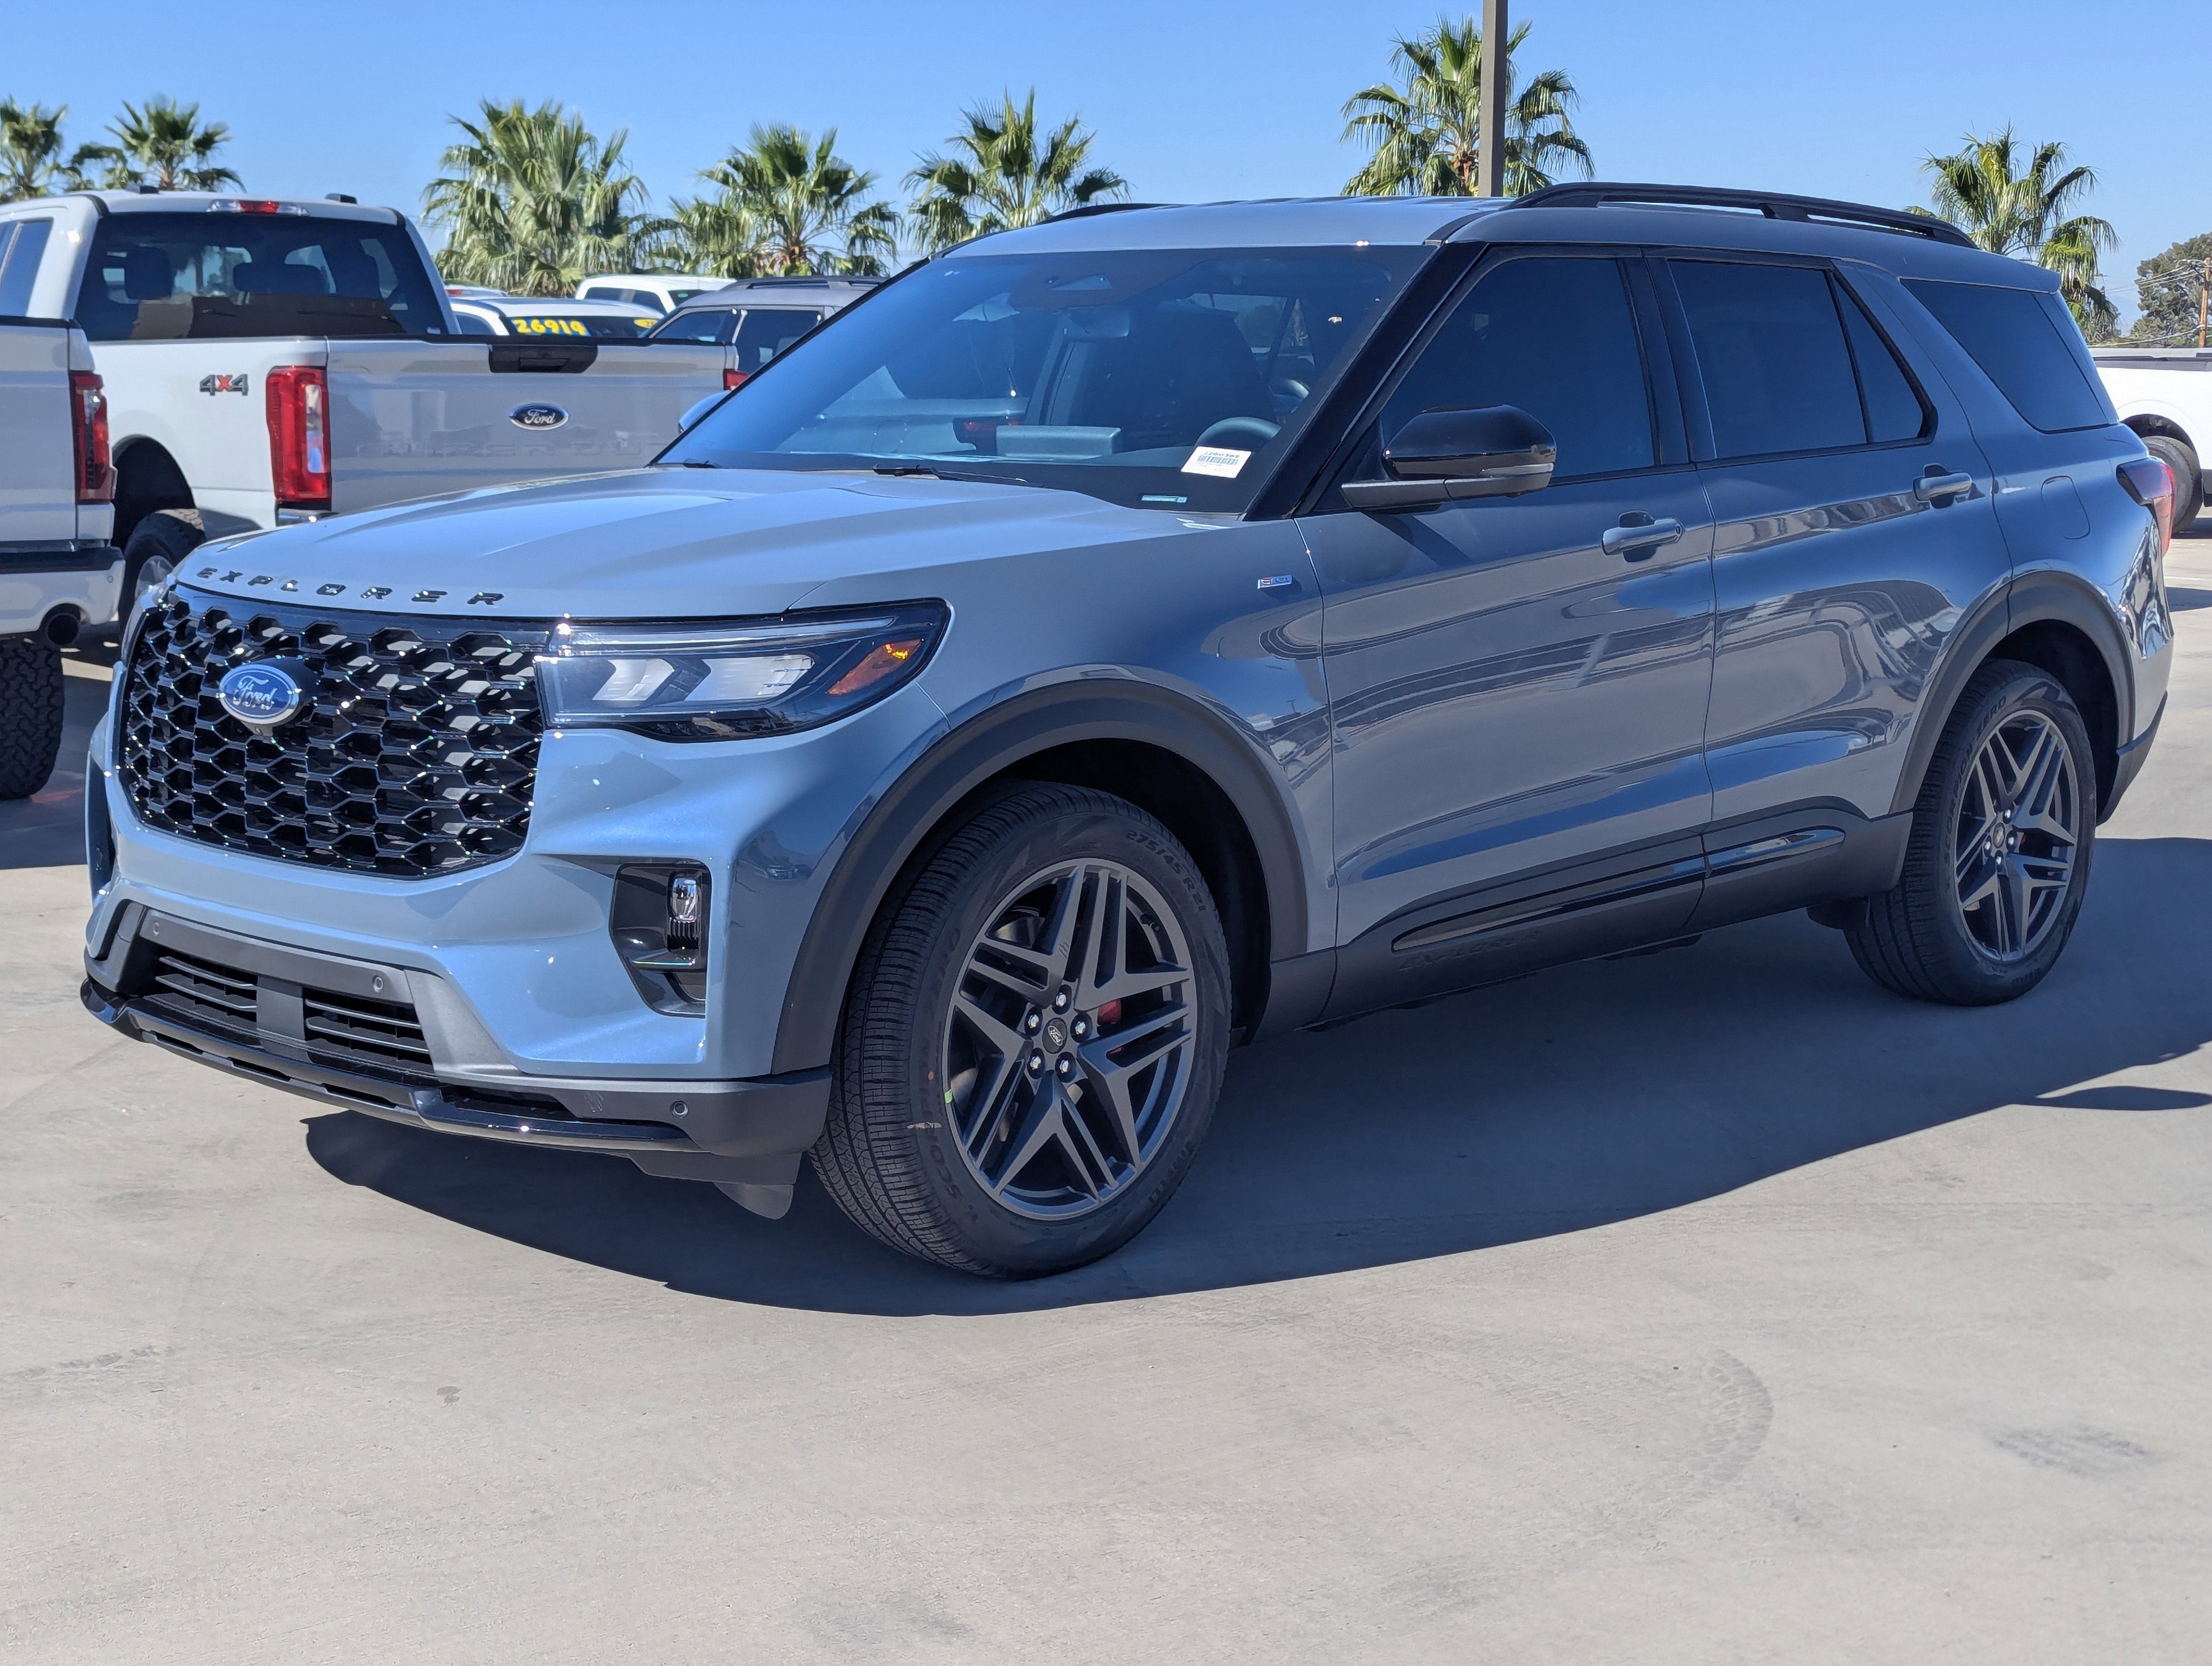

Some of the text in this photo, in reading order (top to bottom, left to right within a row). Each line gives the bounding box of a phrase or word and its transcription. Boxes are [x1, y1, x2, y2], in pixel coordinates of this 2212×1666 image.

[524, 409, 556, 424] Ford
[197, 567, 505, 606] EXPLORER
[233, 675, 278, 710] Ford
[1126, 830, 1206, 911] 275/45 R21
